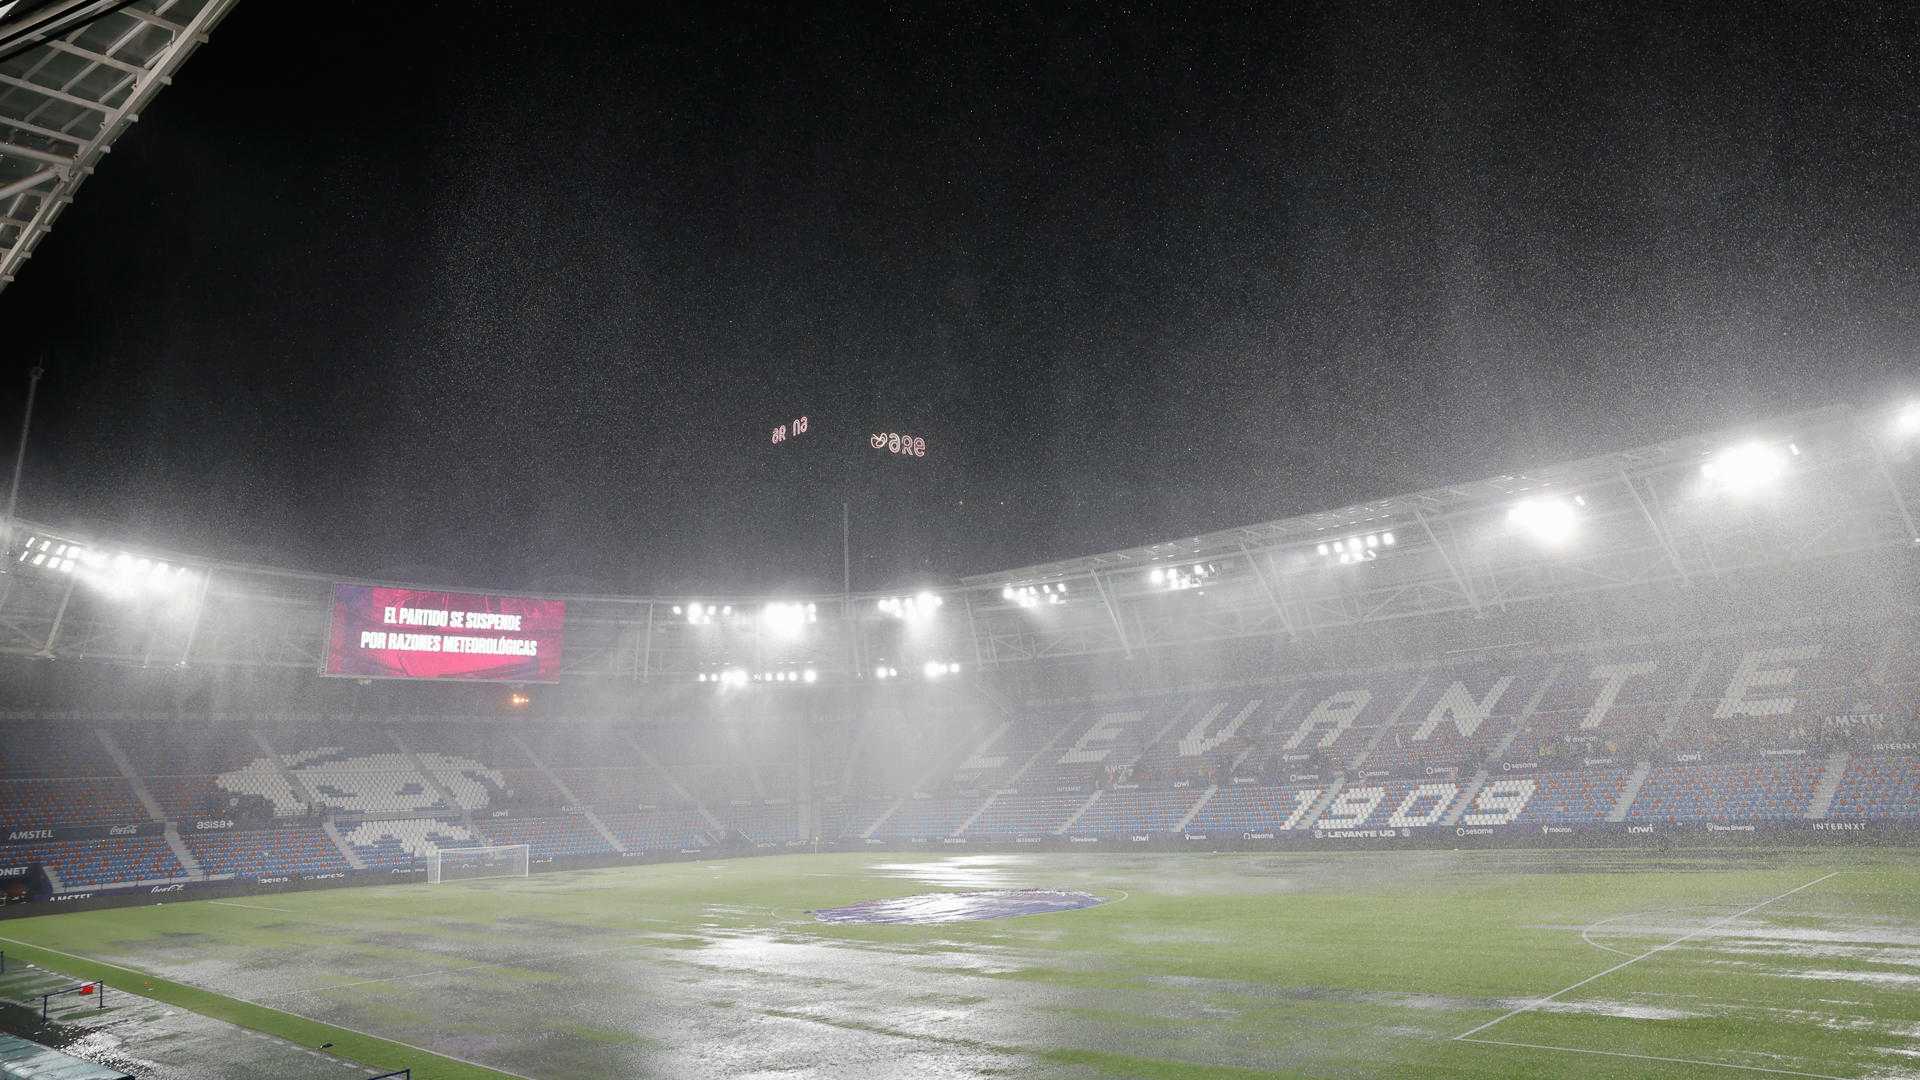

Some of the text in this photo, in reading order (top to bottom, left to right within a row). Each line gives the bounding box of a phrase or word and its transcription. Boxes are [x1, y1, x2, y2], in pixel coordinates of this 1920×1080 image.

[384, 607, 522, 631] EL PARTIDO SE SUSPENDE
[360, 631, 538, 656] POR RAZONES METEOROLÓGICAS
[1280, 780, 1536, 830] 1909
[8, 829, 54, 840] AMSTEL
[1812, 823, 1866, 831] INTERNXT
